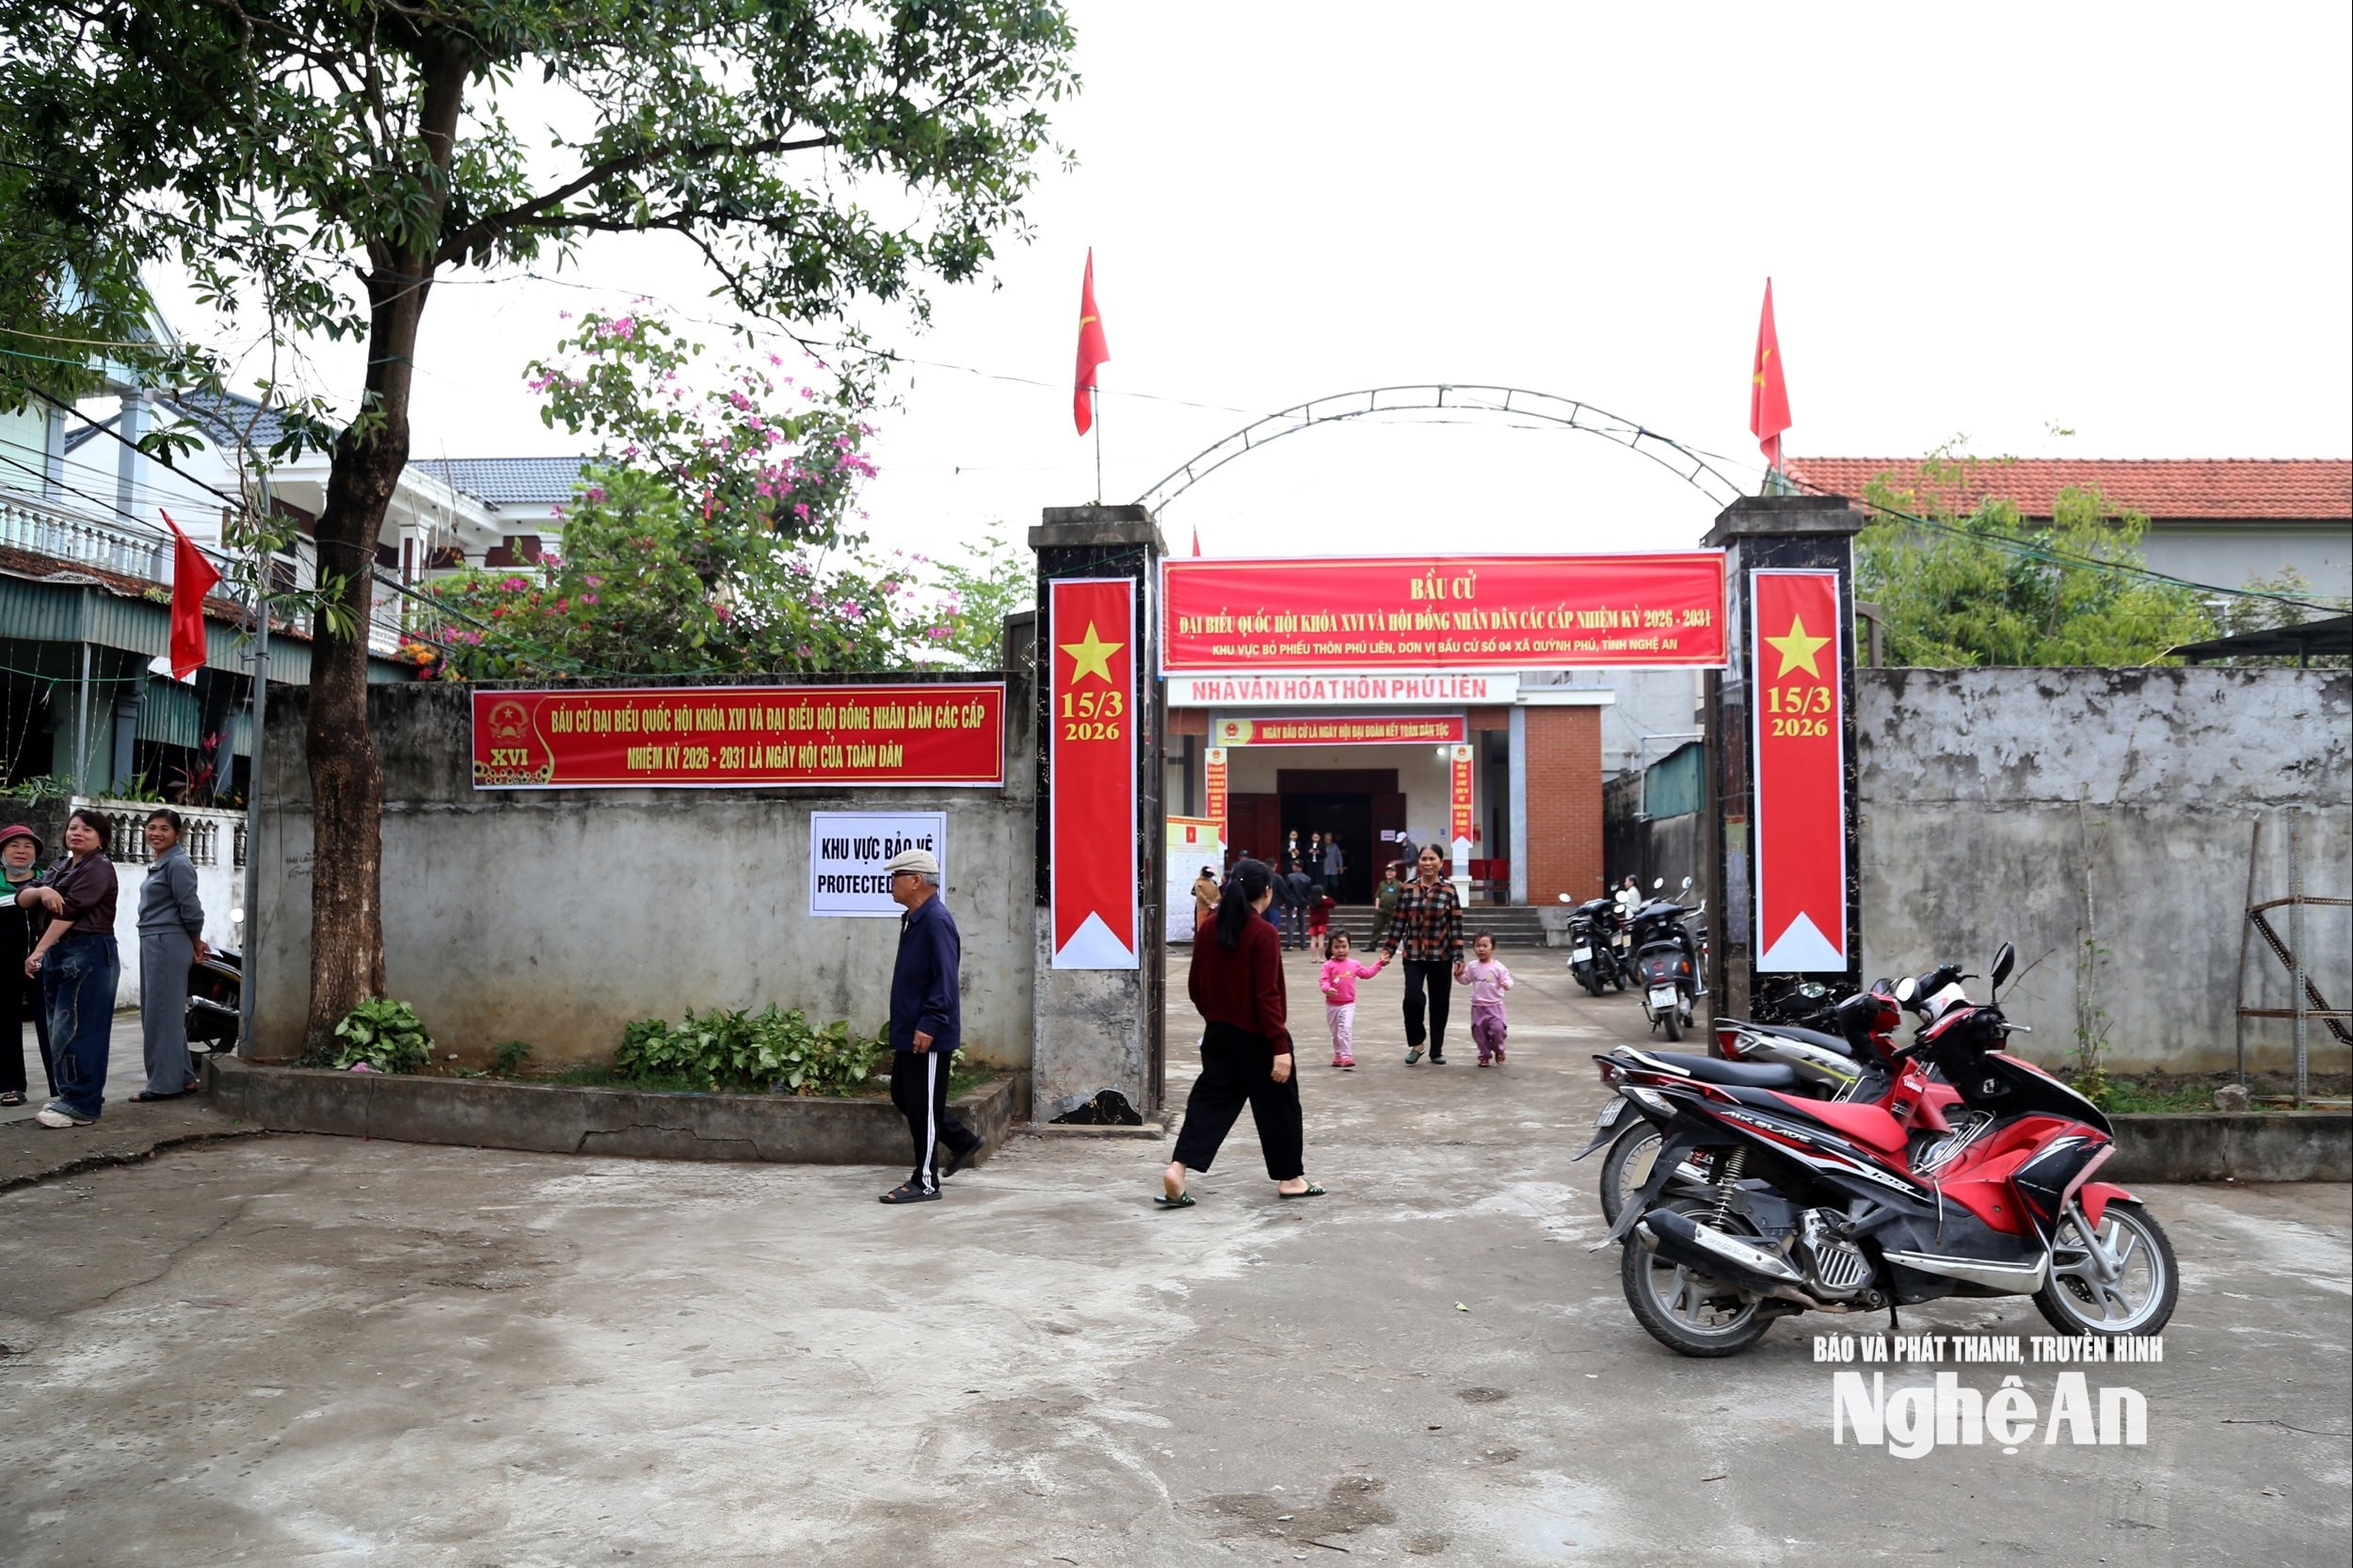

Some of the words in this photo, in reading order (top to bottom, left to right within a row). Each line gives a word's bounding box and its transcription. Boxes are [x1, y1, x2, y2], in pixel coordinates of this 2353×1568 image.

[1410, 568, 1448, 600] BẦU
[1452, 568, 1477, 600] CỬ
[1179, 616, 1202, 640] ĐẠI
[1206, 606, 1235, 633] BIỂU
[1238, 606, 1272, 637] QUỐC
[1274, 610, 1297, 639] HỘI
[1301, 609, 1337, 632] KHÓA
[1341, 615, 1364, 632] XVI
[1368, 608, 1385, 632] VÀ
[1389, 608, 1412, 637] HỘI
[1416, 604, 1449, 631] ĐỒNG
[1453, 607, 1489, 631] NHÂN
[1491, 607, 1517, 630] DÂN
[1520, 606, 1545, 630] CÁC
[1548, 602, 1574, 629] CẤP
[1577, 605, 1618, 634] NHIỆM
[1622, 604, 1641, 628] KỲ
[1644, 610, 1673, 628] 2026
[1683, 609, 1710, 627] 2031
[1212, 644, 1235, 655] KHU
[1238, 644, 1259, 658] VỰC
[1262, 640, 1276, 654] BỎ
[1280, 640, 1310, 654] PHIẾU
[1313, 641, 1342, 653] THÔN
[1346, 641, 1367, 653] PHÚ
[1369, 640, 1395, 654] LIÊN,
[1399, 642, 1421, 653] ĐƠN
[1425, 642, 1435, 656] VỊ
[1463, 637, 1480, 652] CỬ
[1481, 637, 1497, 652] SỐ
[1498, 642, 1512, 652] 04
[1514, 638, 1529, 651] XÃ
[1533, 638, 1571, 651] QUỲNH
[1574, 637, 1599, 652] PHÚ,
[1602, 635, 1626, 649] TỈNH
[1629, 636, 1658, 652] NGHỆ
[1662, 639, 1677, 649] AN
[1193, 676, 1236, 700] NHÀ
[1239, 676, 1280, 700] VĂN
[1285, 675, 1326, 699] HÓA
[1328, 675, 1386, 699] THÔN
[1392, 674, 1434, 698] PHÚ
[1768, 686, 1832, 715] 15/3
[552, 703, 572, 732] BẦU
[576, 700, 593, 732] CỬ
[593, 710, 611, 738] ĐẠI
[615, 700, 639, 732] BIỂU
[642, 700, 671, 734] QUỐC
[674, 704, 693, 737] HỘI
[696, 704, 725, 730] KHÓA
[728, 708, 745, 730] XVI
[749, 703, 763, 730] VÀ
[766, 708, 785, 736] ĐẠI
[789, 698, 813, 730] BIỂU
[817, 703, 836, 735] HỘI
[840, 699, 870, 729] ĐỒNG
[873, 701, 904, 729] NHÂN
[908, 701, 932, 728] DÂN
[936, 700, 958, 728] CÁC
[961, 697, 984, 728] CẤP
[1062, 691, 1123, 720] 15/3
[1065, 723, 1119, 740] 2026
[1771, 718, 1828, 737] 2026
[490, 748, 528, 766] XVI
[627, 743, 662, 775] NHIỆM
[665, 742, 680, 769] KỲ
[682, 746, 709, 769] 2026
[720, 746, 744, 769] 2031
[749, 741, 762, 768] LÀ
[765, 741, 795, 768] NGÀY
[799, 741, 817, 774] HỘI
[821, 735, 843, 768] CỦA
[846, 740, 875, 767] TOÀN
[878, 740, 904, 767] DÂN
[822, 838, 849, 859] KHU
[854, 836, 880, 865] VỰC
[818, 875, 892, 893] PROTECTED
